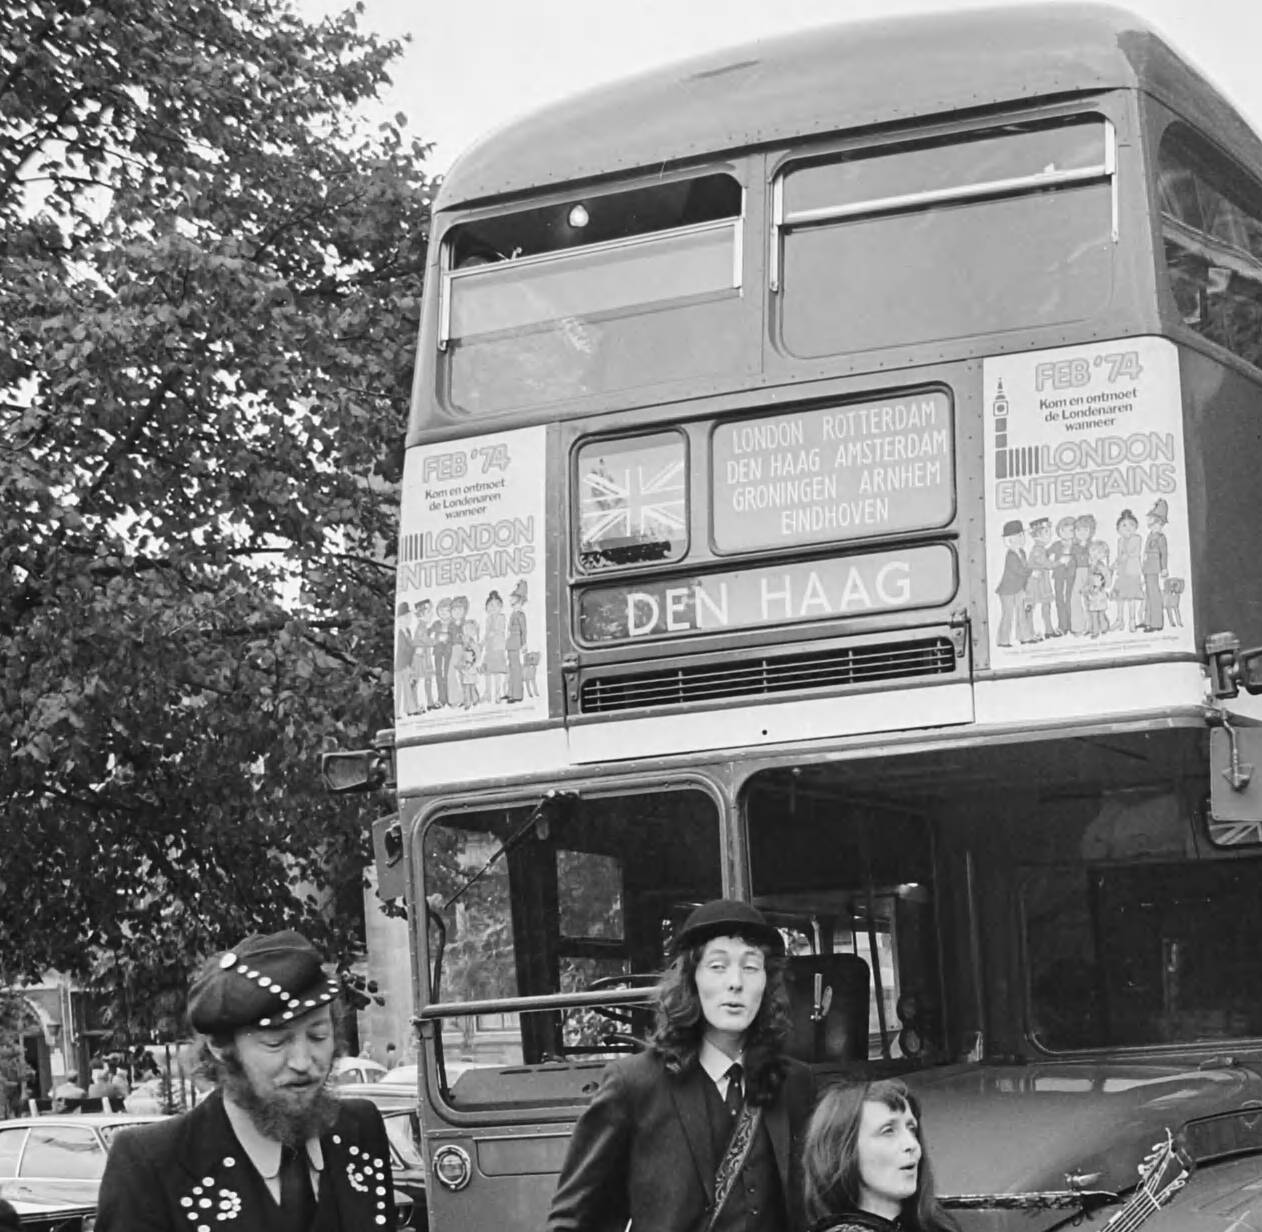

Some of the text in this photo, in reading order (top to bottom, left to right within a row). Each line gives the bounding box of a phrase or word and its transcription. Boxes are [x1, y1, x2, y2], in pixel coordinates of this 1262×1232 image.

[1035, 351, 1144, 392] FEB '74
[1039, 388, 1138, 411] Kom en ontmoet
[1045, 403, 1133, 422] de Londenaren
[732, 401, 936, 454] LONDON ROTTERDAM
[1065, 416, 1116, 432] wanneer
[423, 451, 468, 483] FEB
[727, 429, 947, 485] DEN HAAG AMSTERDAM
[1040, 431, 1175, 474] LONDON
[425, 478, 505, 500] Kom en ontmoet
[429, 500, 441, 511] de
[732, 461, 941, 512] GRONINGEN ARNHEM
[995, 463, 1177, 510] ENTERTAINS
[781, 498, 889, 534] EINDHOVEN
[425, 515, 534, 559] LONDON
[626, 561, 911, 637] DEN HAAG
